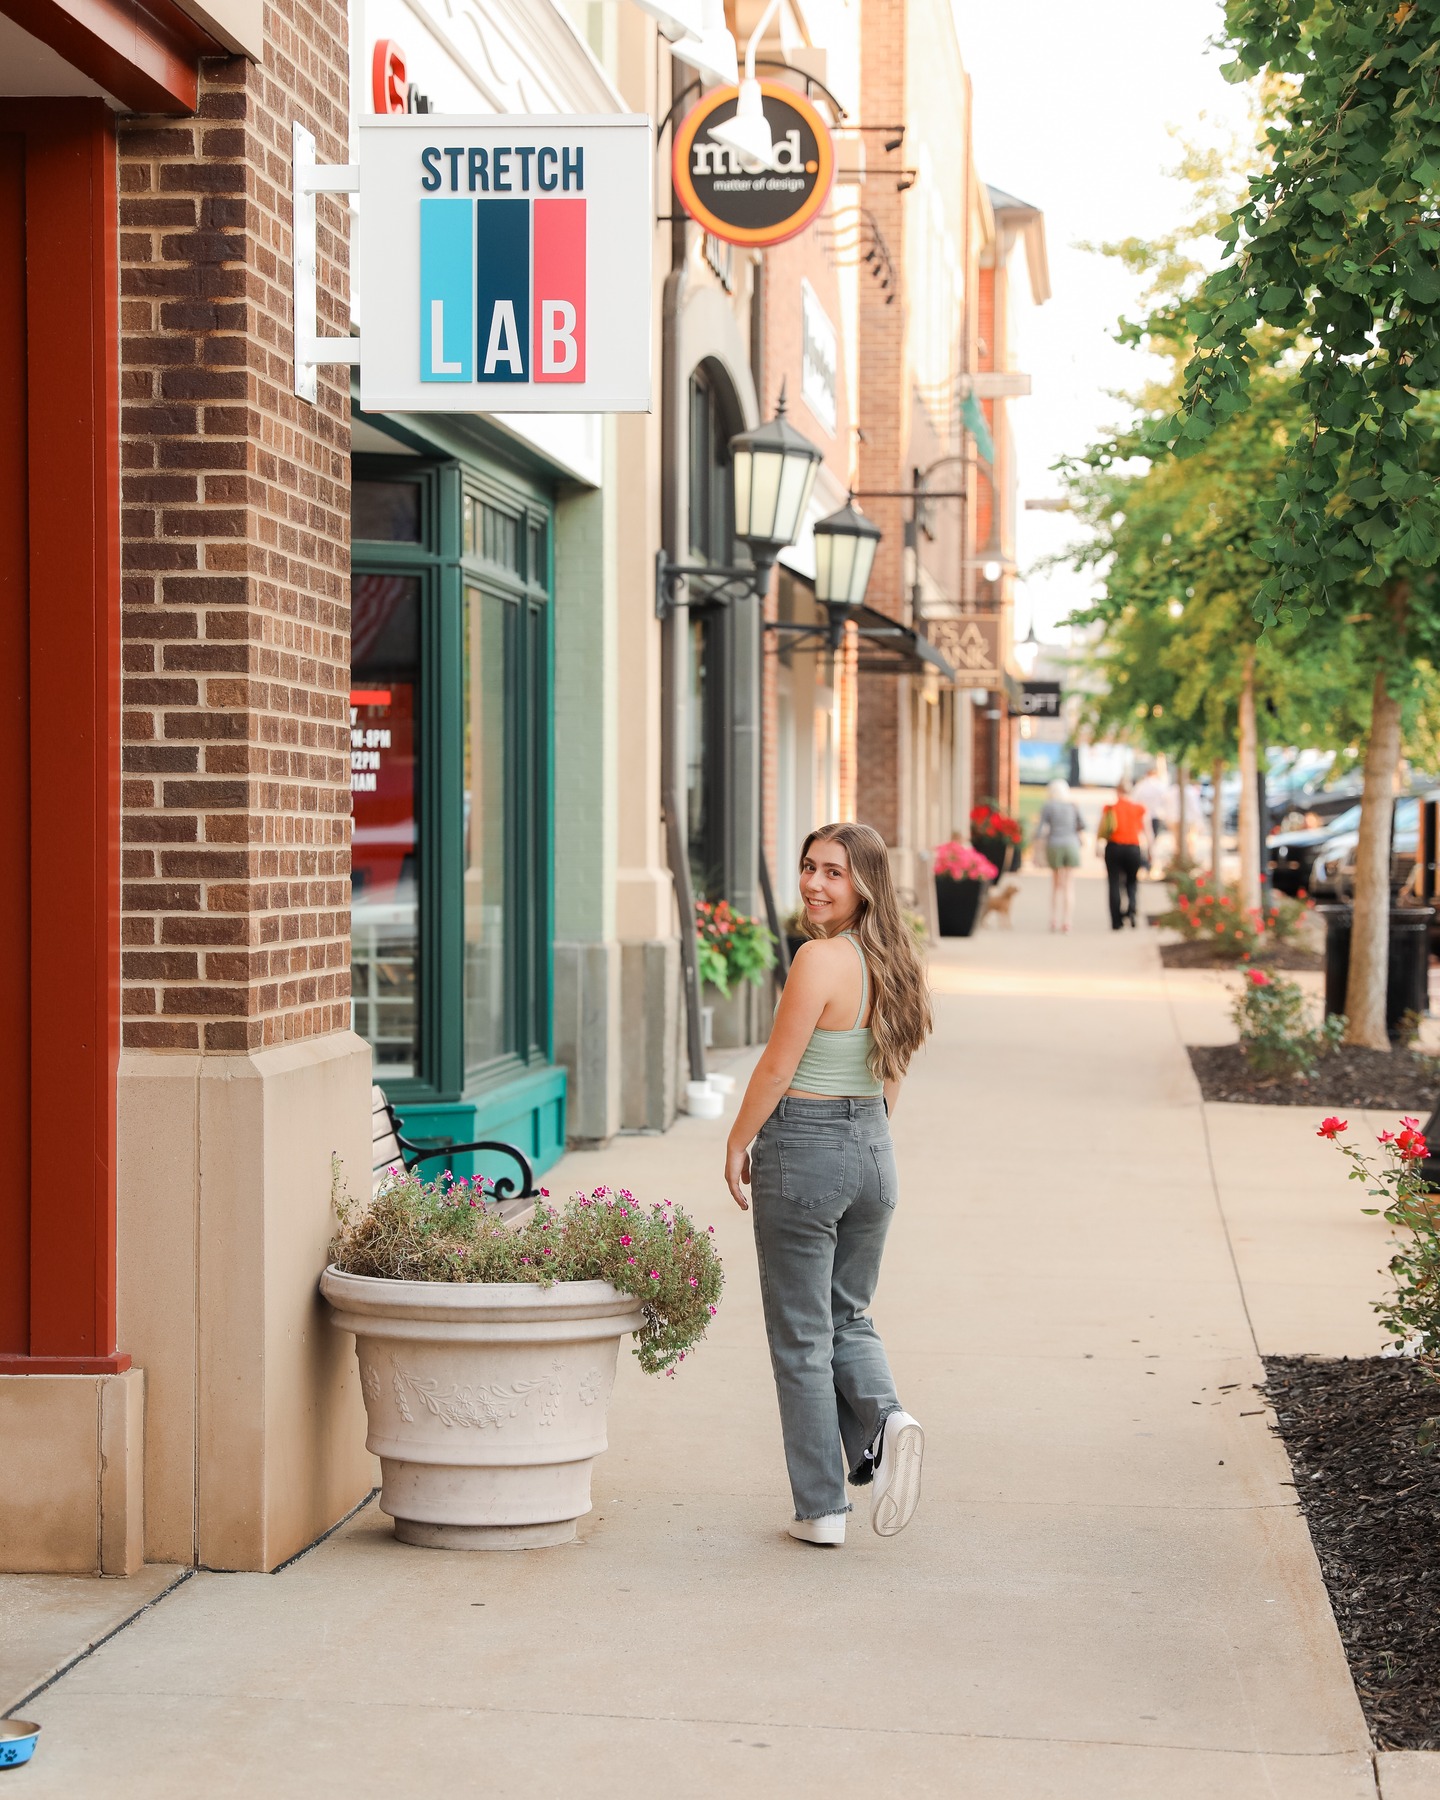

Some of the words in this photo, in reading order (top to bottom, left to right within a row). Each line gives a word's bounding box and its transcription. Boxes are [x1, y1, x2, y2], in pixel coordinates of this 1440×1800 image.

[421, 147, 584, 191] STRETCH
[713, 179, 751, 191] matter
[752, 177, 766, 191] of
[766, 177, 805, 192] design
[431, 300, 578, 374] LAB
[939, 645, 993, 670] NK
[1009, 692, 1058, 714] OFT
